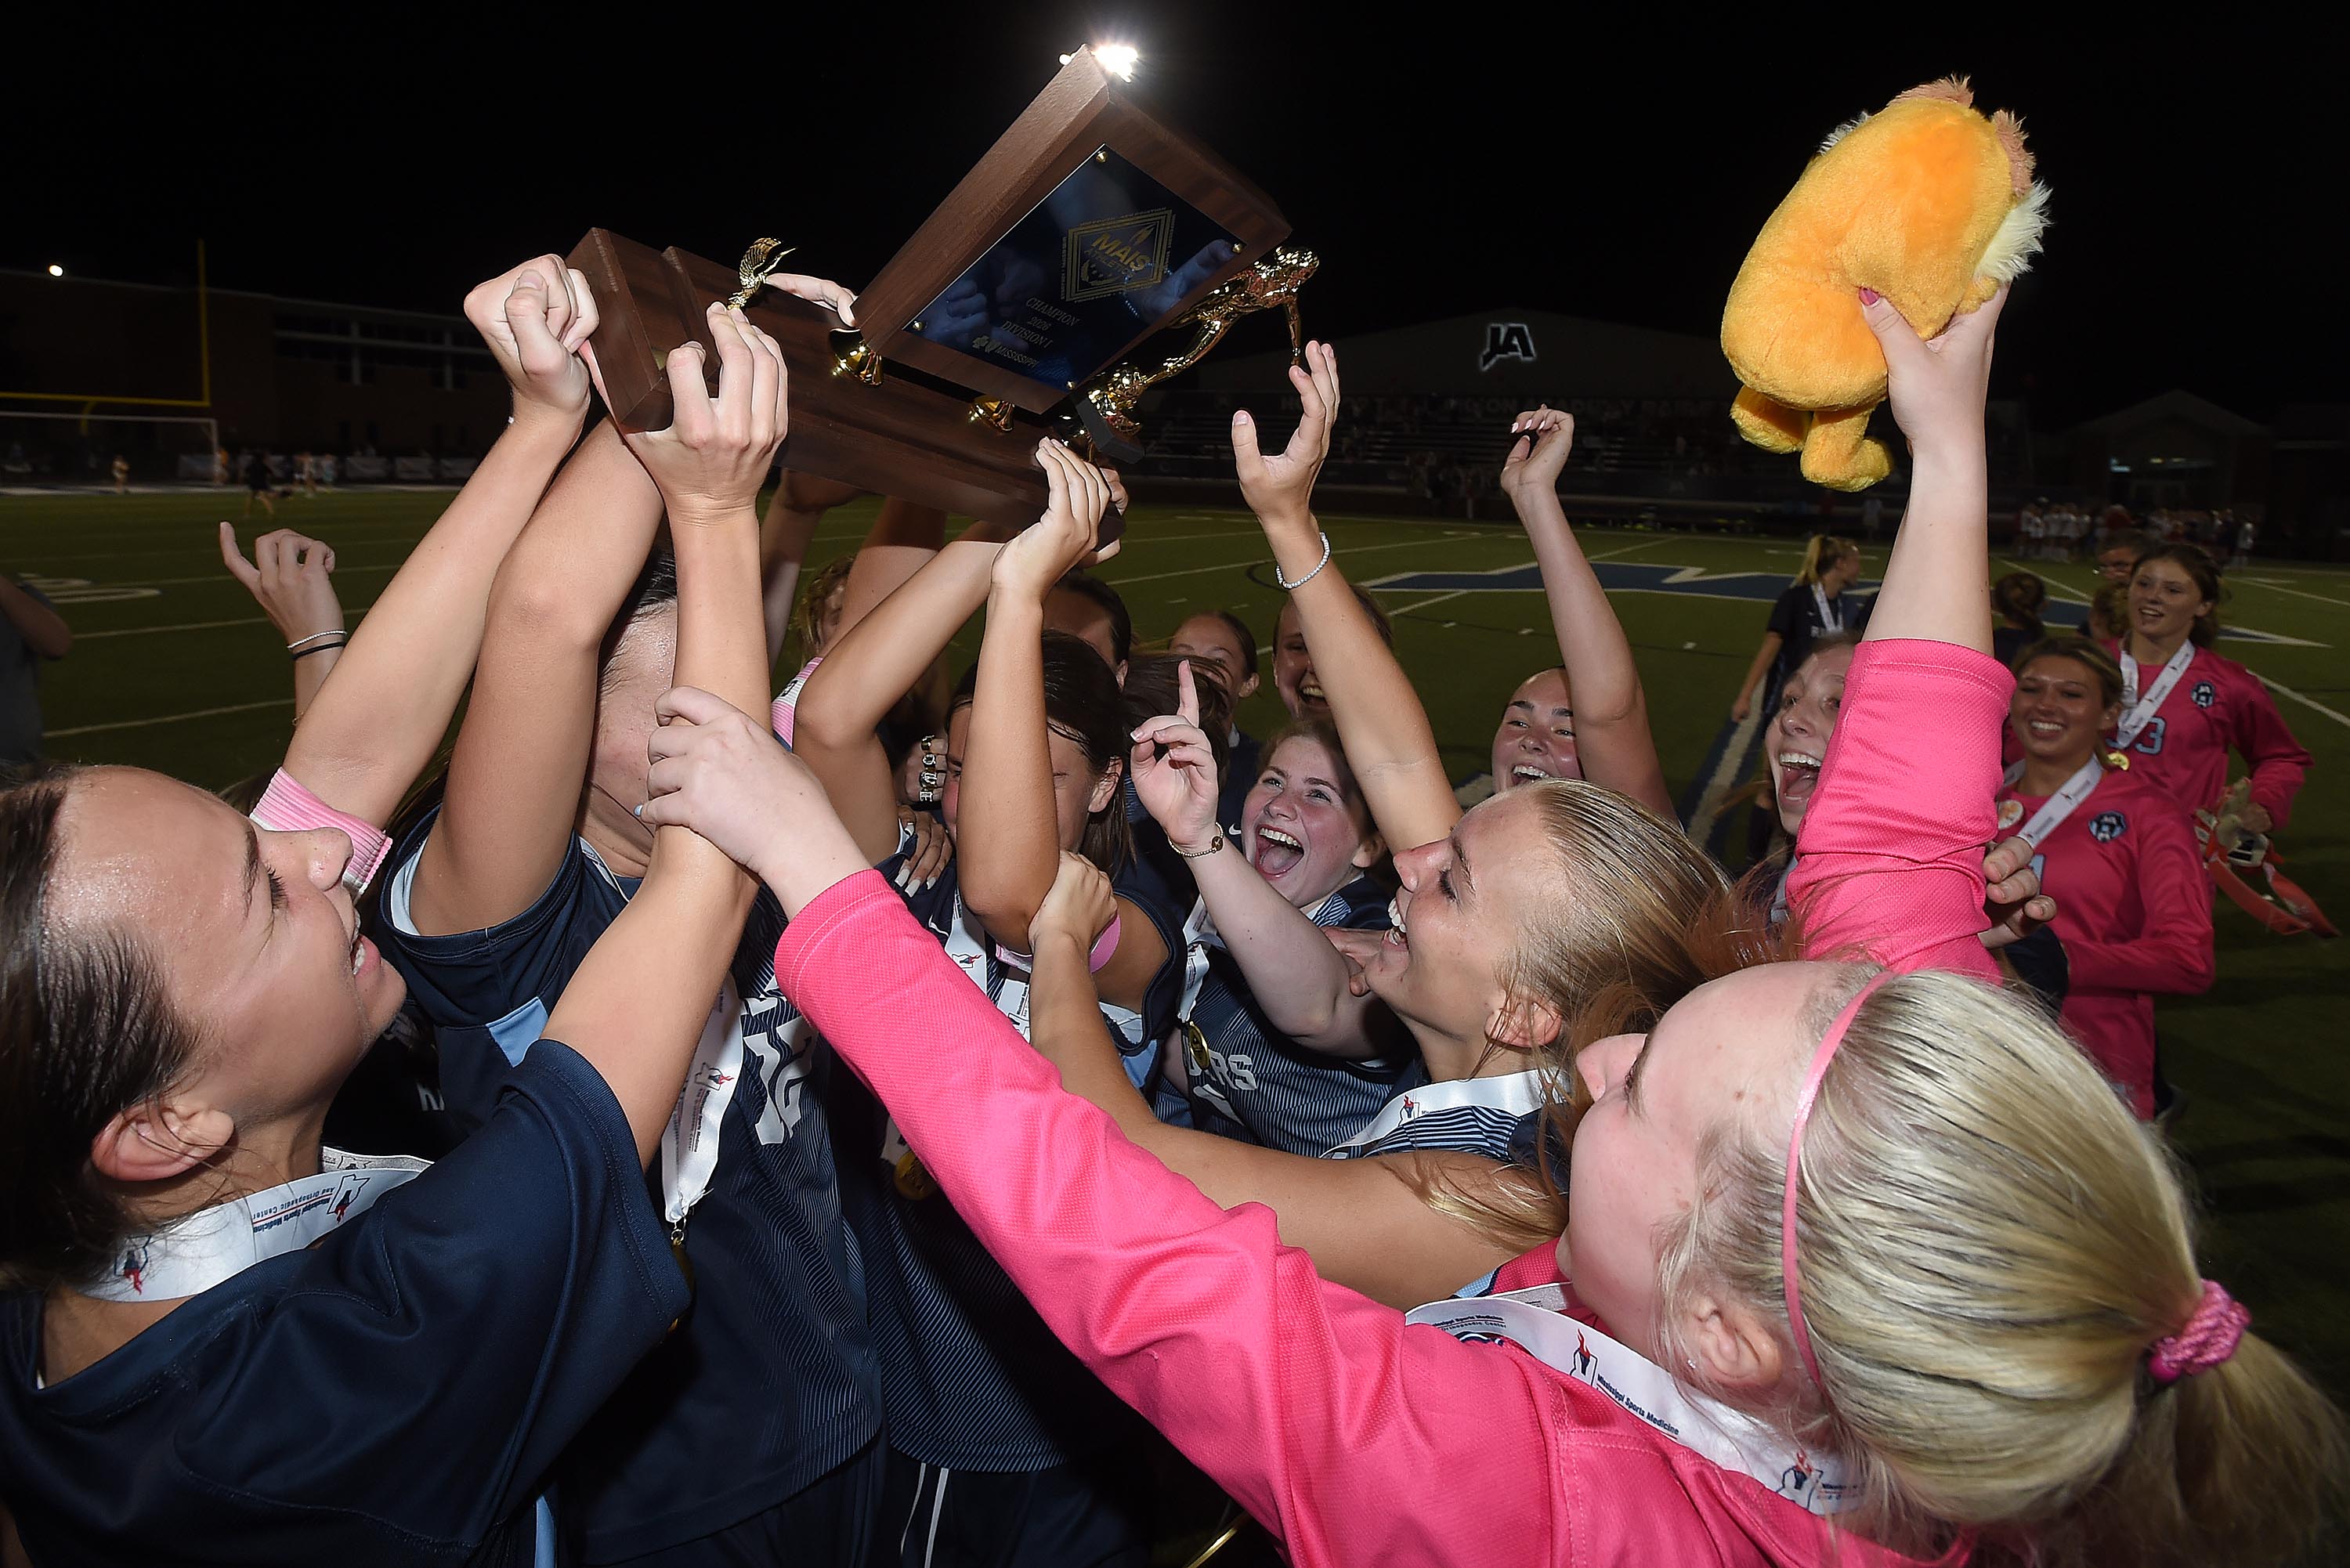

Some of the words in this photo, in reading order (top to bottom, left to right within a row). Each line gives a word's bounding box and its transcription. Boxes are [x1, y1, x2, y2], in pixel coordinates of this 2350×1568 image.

[1090, 233, 1152, 271] MAIS
[1025, 297, 1079, 327] CHAMPION
[1003, 320, 1045, 345] DIVISION
[995, 345, 1040, 368] MISSISSIPPI
[1479, 322, 1537, 372] JA
[253, 1205, 278, 1219] Center
[253, 1217, 283, 1233] Medicine
[1597, 1373, 1625, 1402] Mississippi
[1625, 1397, 1645, 1417] Sports
[1647, 1412, 1679, 1436] Medicine
